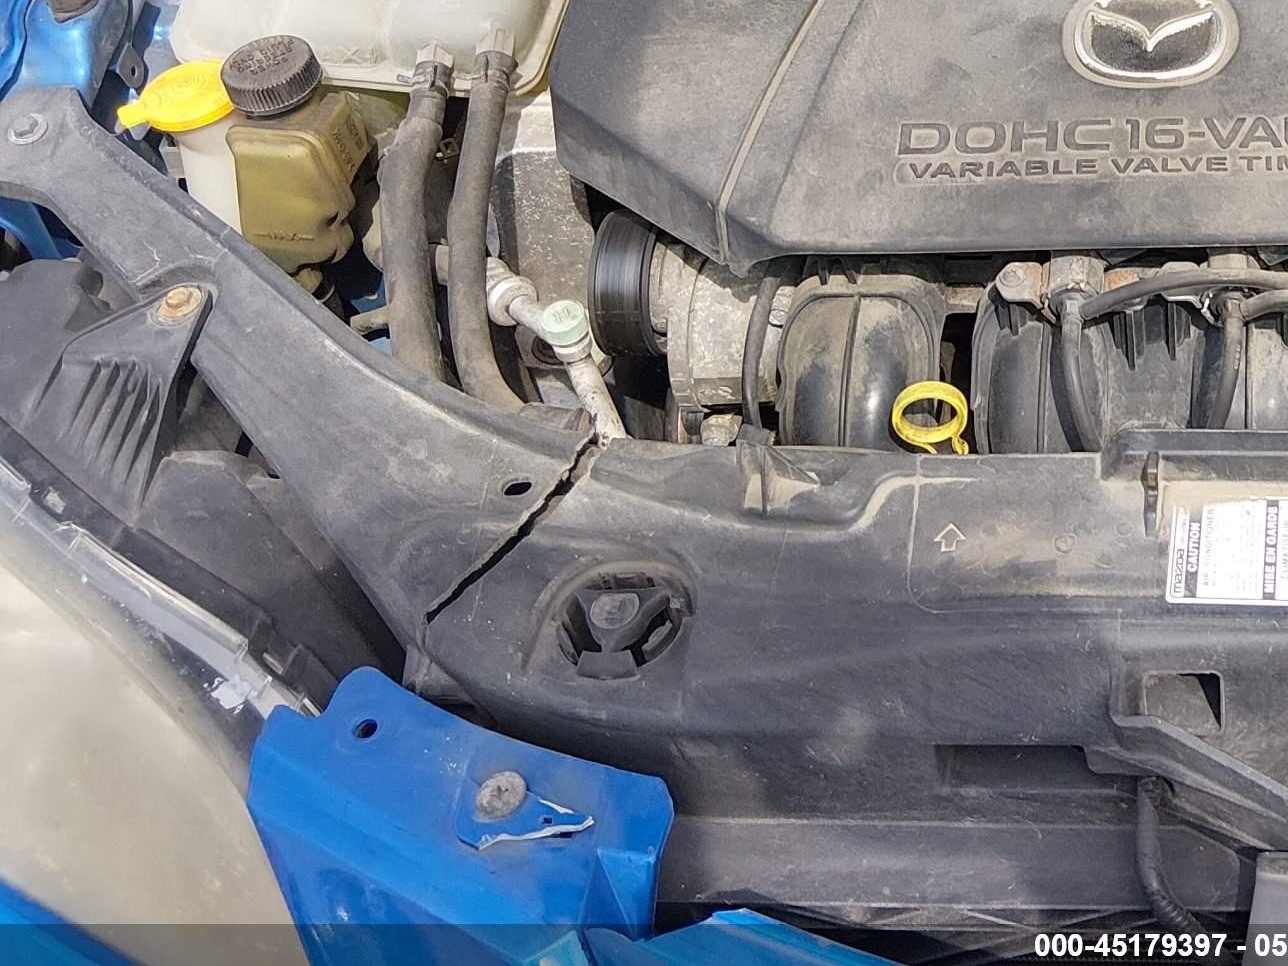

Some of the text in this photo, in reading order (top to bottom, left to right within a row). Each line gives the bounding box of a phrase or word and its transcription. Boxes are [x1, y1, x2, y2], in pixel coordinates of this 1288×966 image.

[897, 118, 1112, 155] DOHC
[908, 158, 1098, 179] VARIABLE
[1111, 155, 1228, 174] VALVE
[1187, 522, 1200, 573] CAUTION
[1264, 506, 1279, 593] MISE EN GARDE
